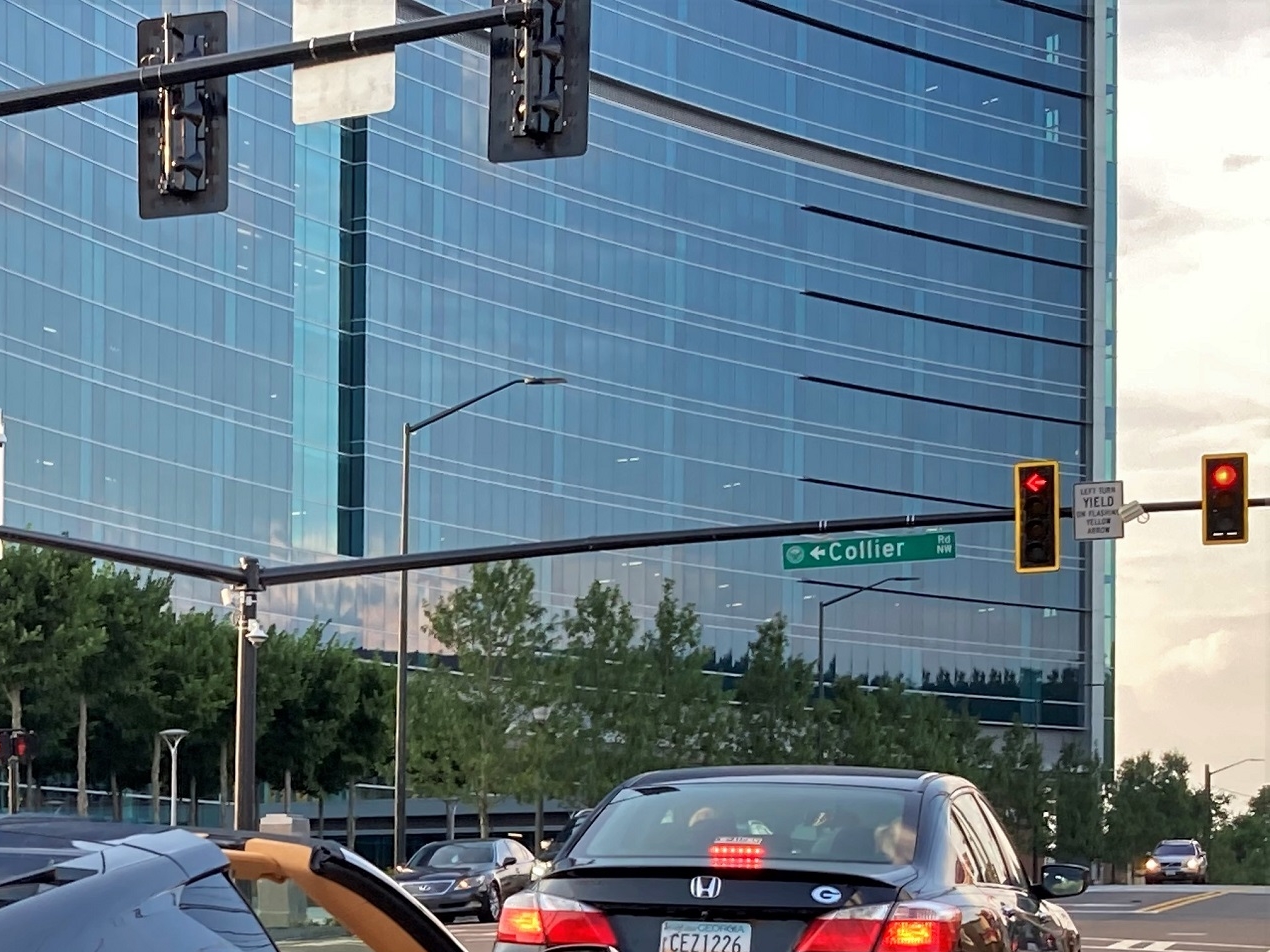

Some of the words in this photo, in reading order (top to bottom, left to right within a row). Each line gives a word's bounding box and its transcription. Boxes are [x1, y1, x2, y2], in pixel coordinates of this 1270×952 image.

[1080, 488, 1096, 496] LEFT
[1099, 486, 1116, 494] TURN
[1083, 496, 1114, 508] YIELD
[829, 539, 905, 562] Collier
[937, 534, 951, 544] Rd
[936, 544, 952, 554] NW
[697, 924, 744, 933] GEORGIA
